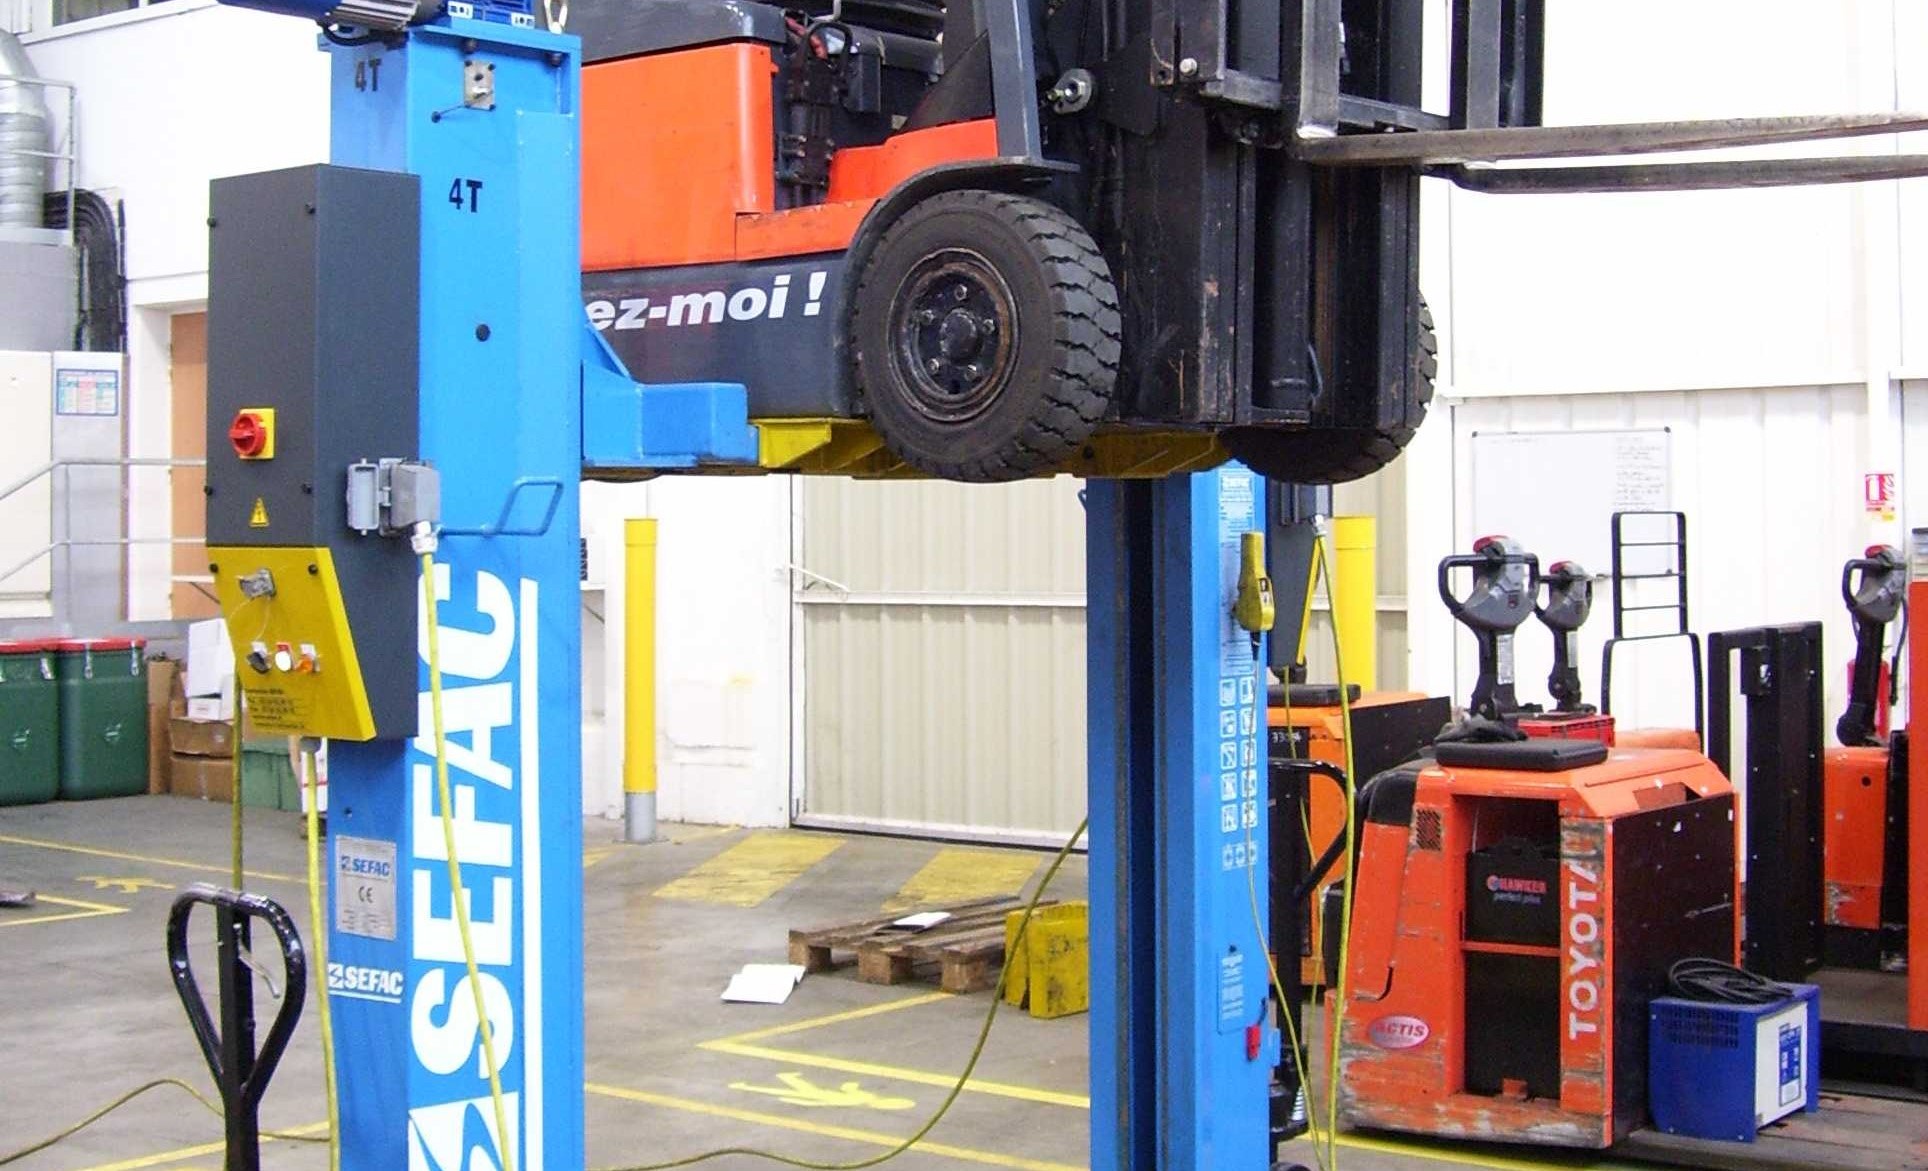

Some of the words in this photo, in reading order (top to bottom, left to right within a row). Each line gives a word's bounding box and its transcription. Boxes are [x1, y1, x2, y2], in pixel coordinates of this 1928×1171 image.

[355, 58, 382, 92] 4T
[449, 178, 483, 213] 4T
[411, 562, 515, 1079] SEFAC
[352, 858, 390, 877] SEFAC
[345, 966, 404, 995] SEFAC
